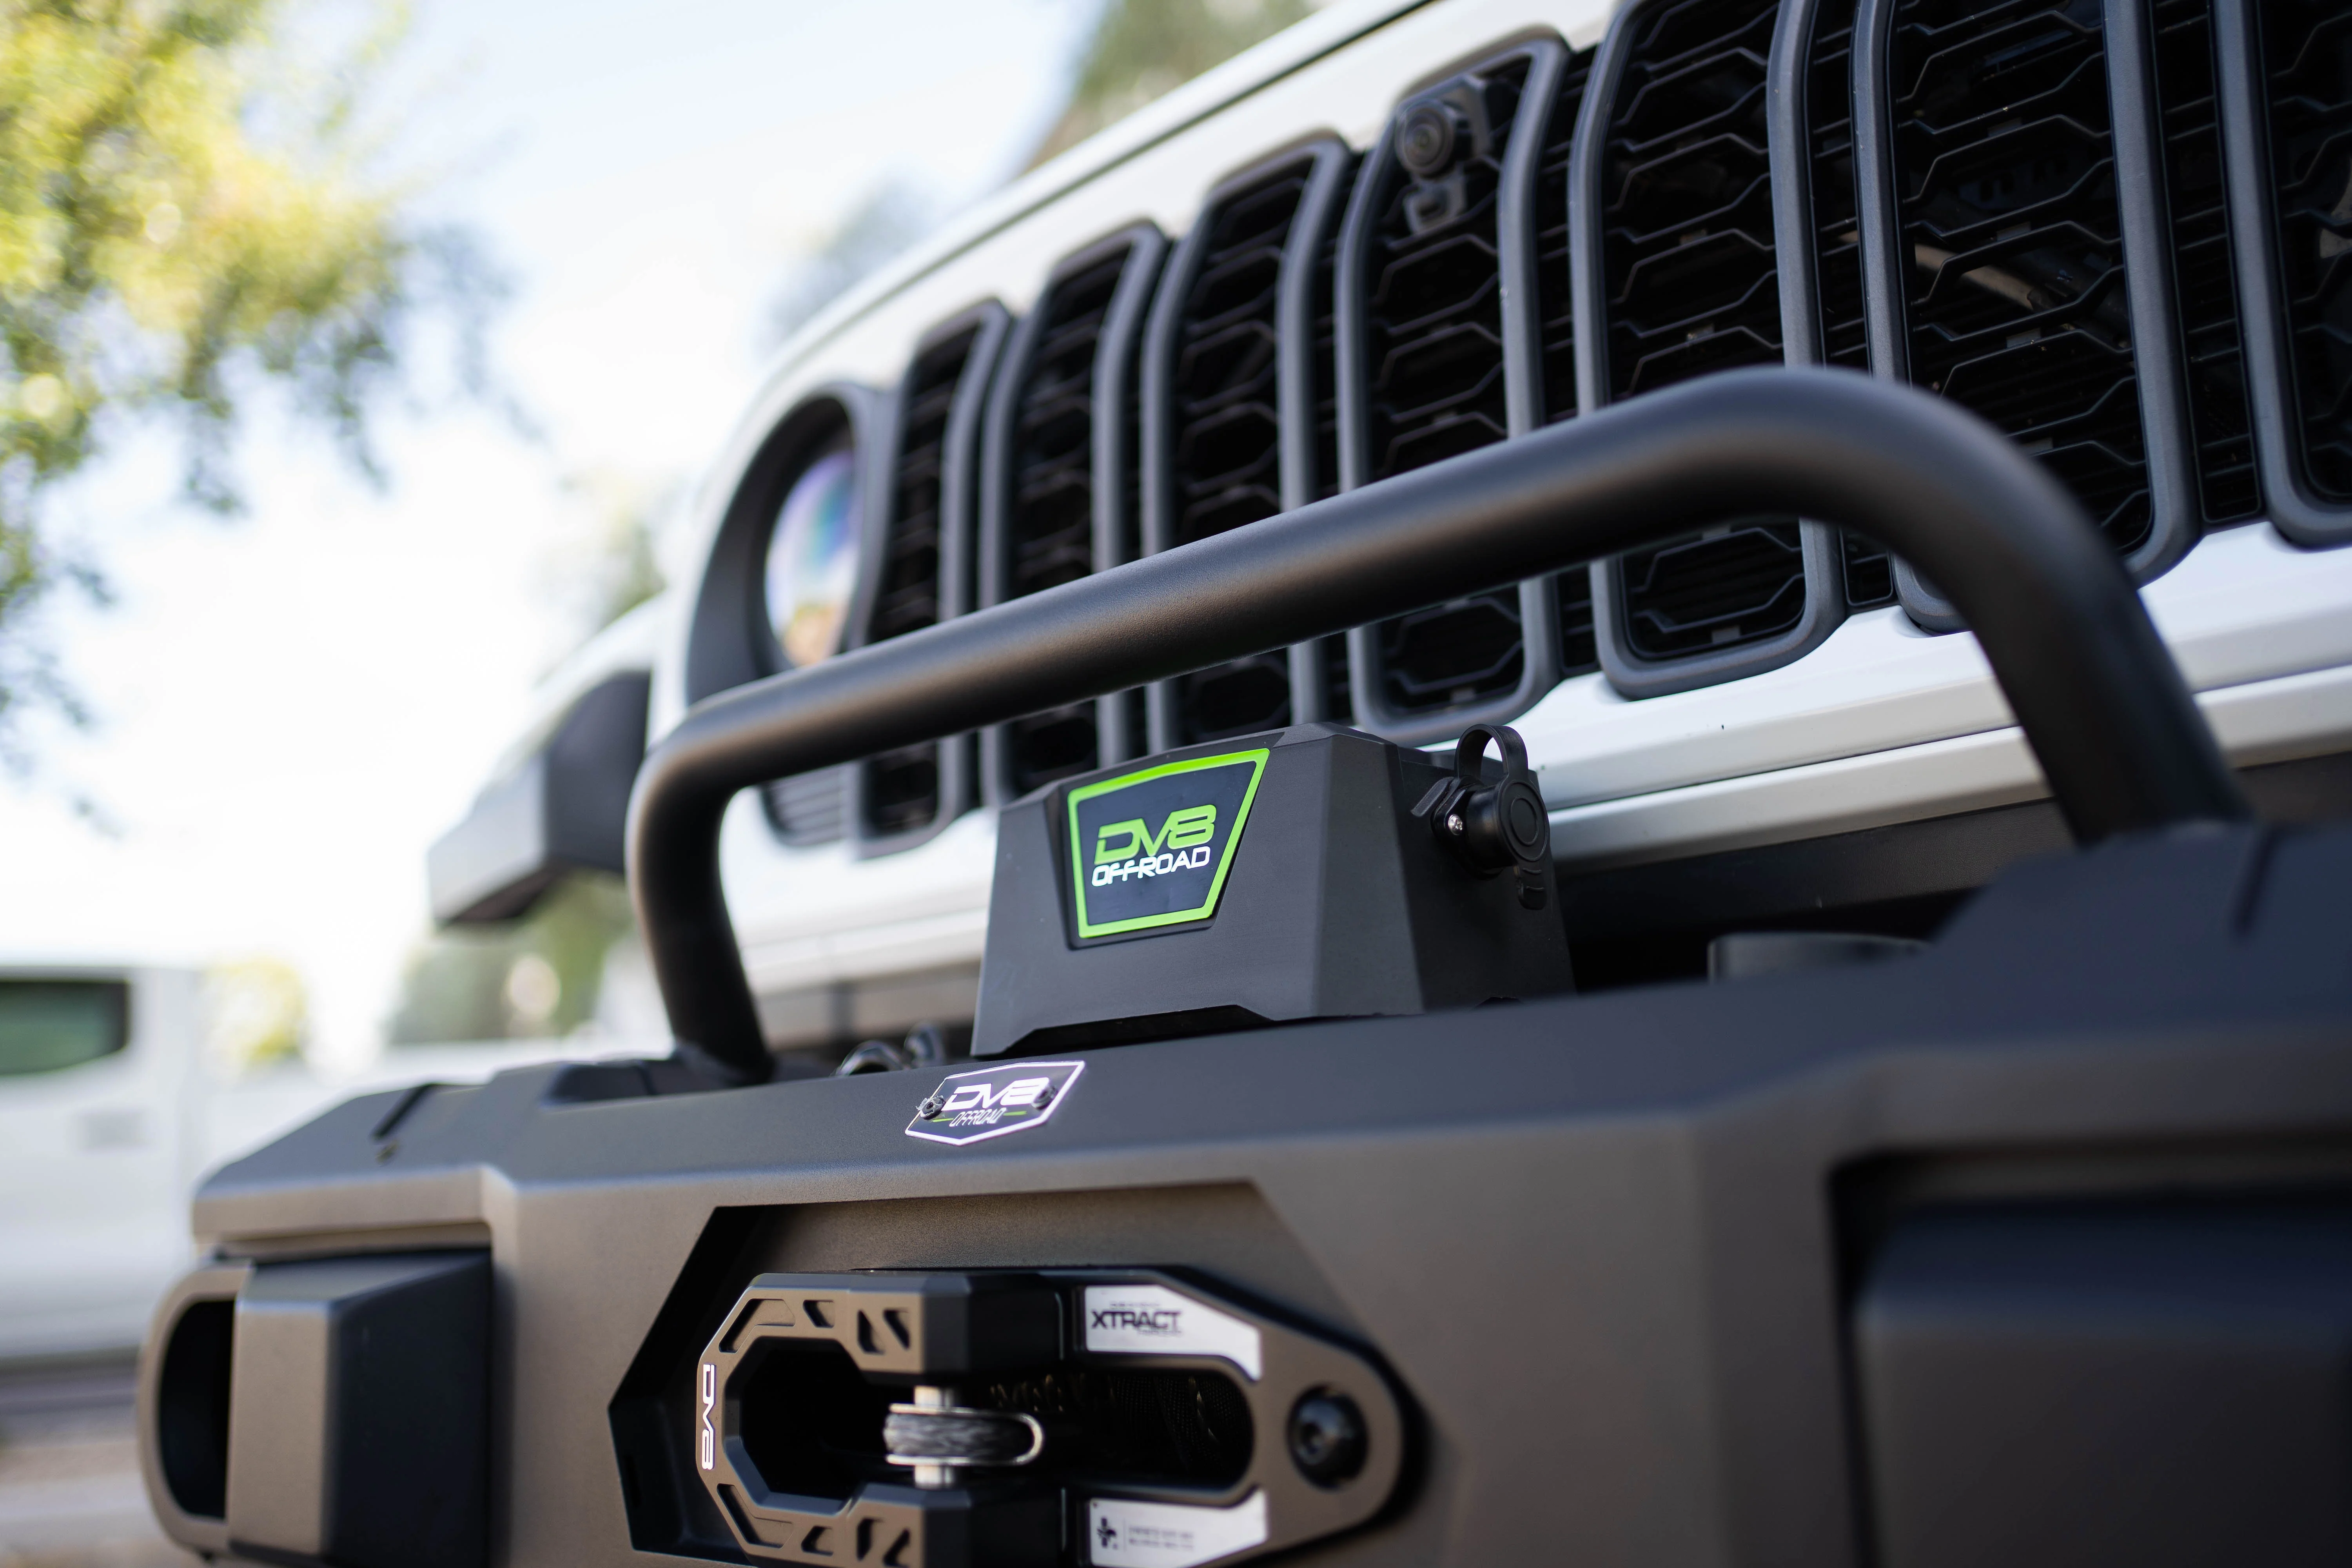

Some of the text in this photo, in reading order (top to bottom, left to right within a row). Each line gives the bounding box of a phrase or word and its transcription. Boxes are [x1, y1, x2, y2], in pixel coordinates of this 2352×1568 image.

[1094, 804, 1216, 864] DV8
[941, 1077, 1050, 1111] DV8
[949, 1107, 1007, 1127] OFFROAD
[1091, 1310, 1181, 1330] XTRACT
[702, 1364, 715, 1470] DV8
